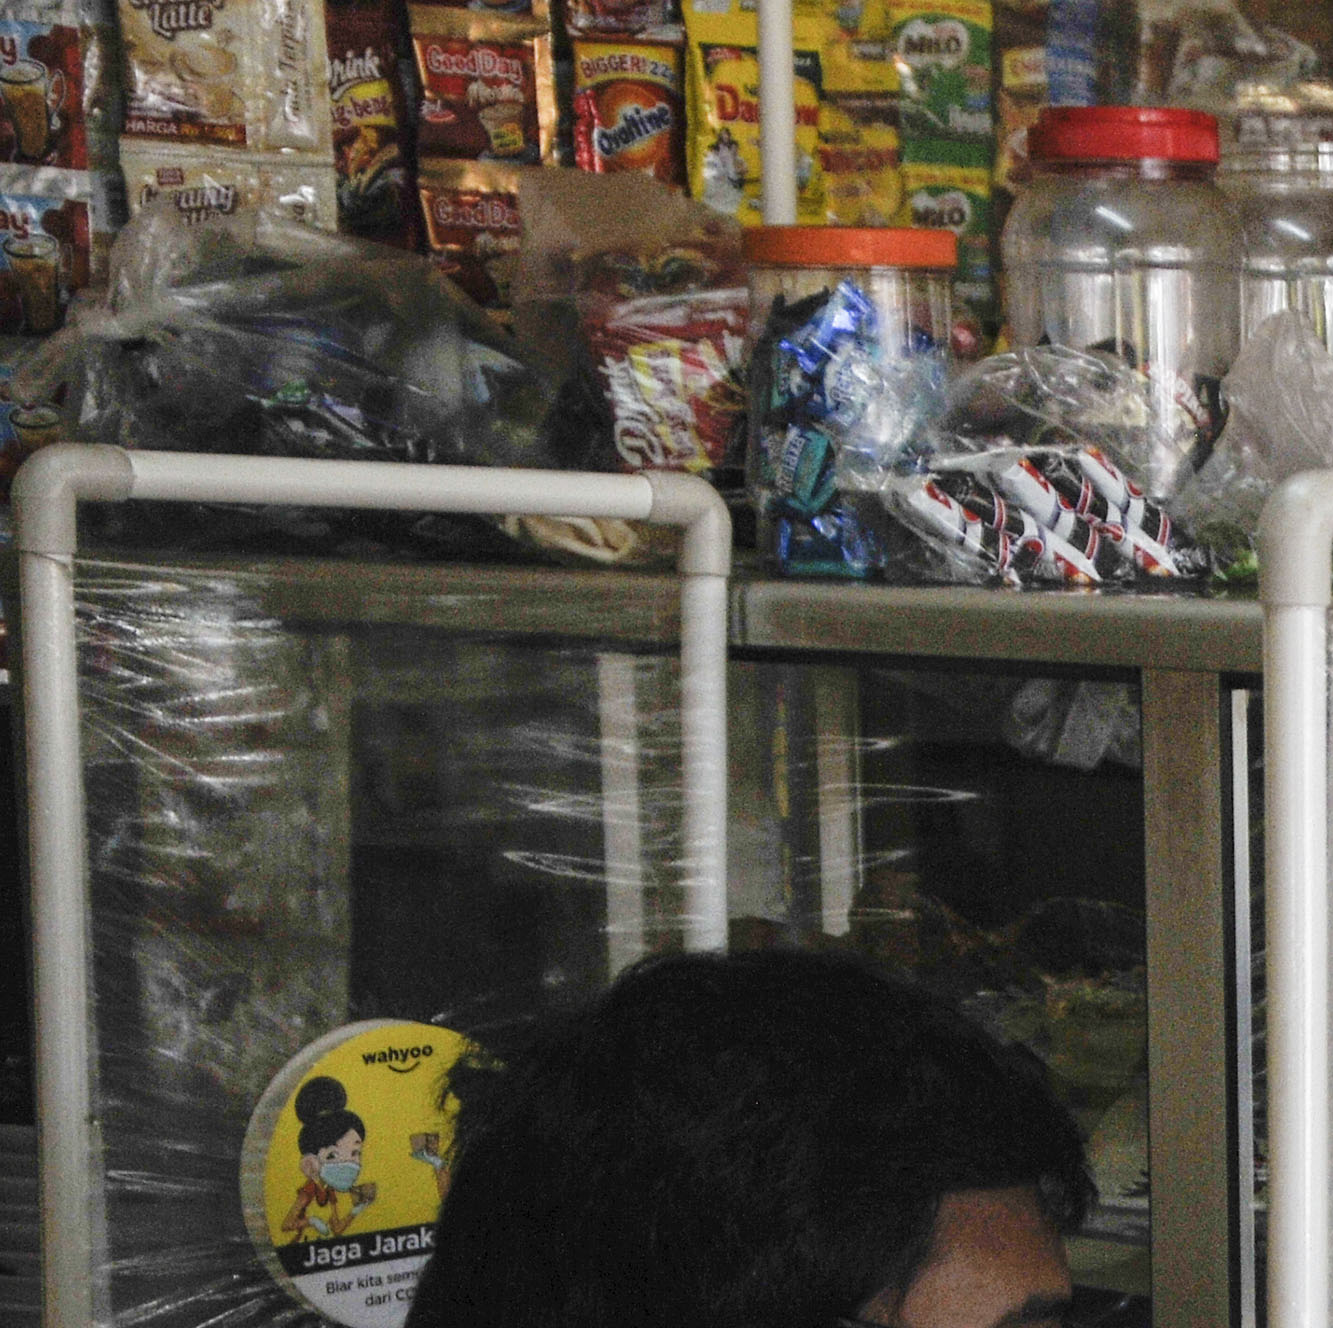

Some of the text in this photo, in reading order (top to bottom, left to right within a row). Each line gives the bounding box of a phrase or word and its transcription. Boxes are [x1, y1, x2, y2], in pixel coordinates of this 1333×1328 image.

[151, 2, 213, 41] Latte
[904, 35, 962, 52] MILO
[327, 47, 381, 93] rink
[426, 45, 477, 76] Good
[125, 119, 179, 135] HARGA
[597, 104, 672, 156] Ovaltine
[488, 202, 520, 229] Da
[361, 1043, 434, 1066] wahyoo
[303, 1227, 436, 1269] Jaga Jarak
[326, 1281, 354, 1296] Biar
[357, 1272, 383, 1291] kita
[365, 1289, 391, 1308] dari
